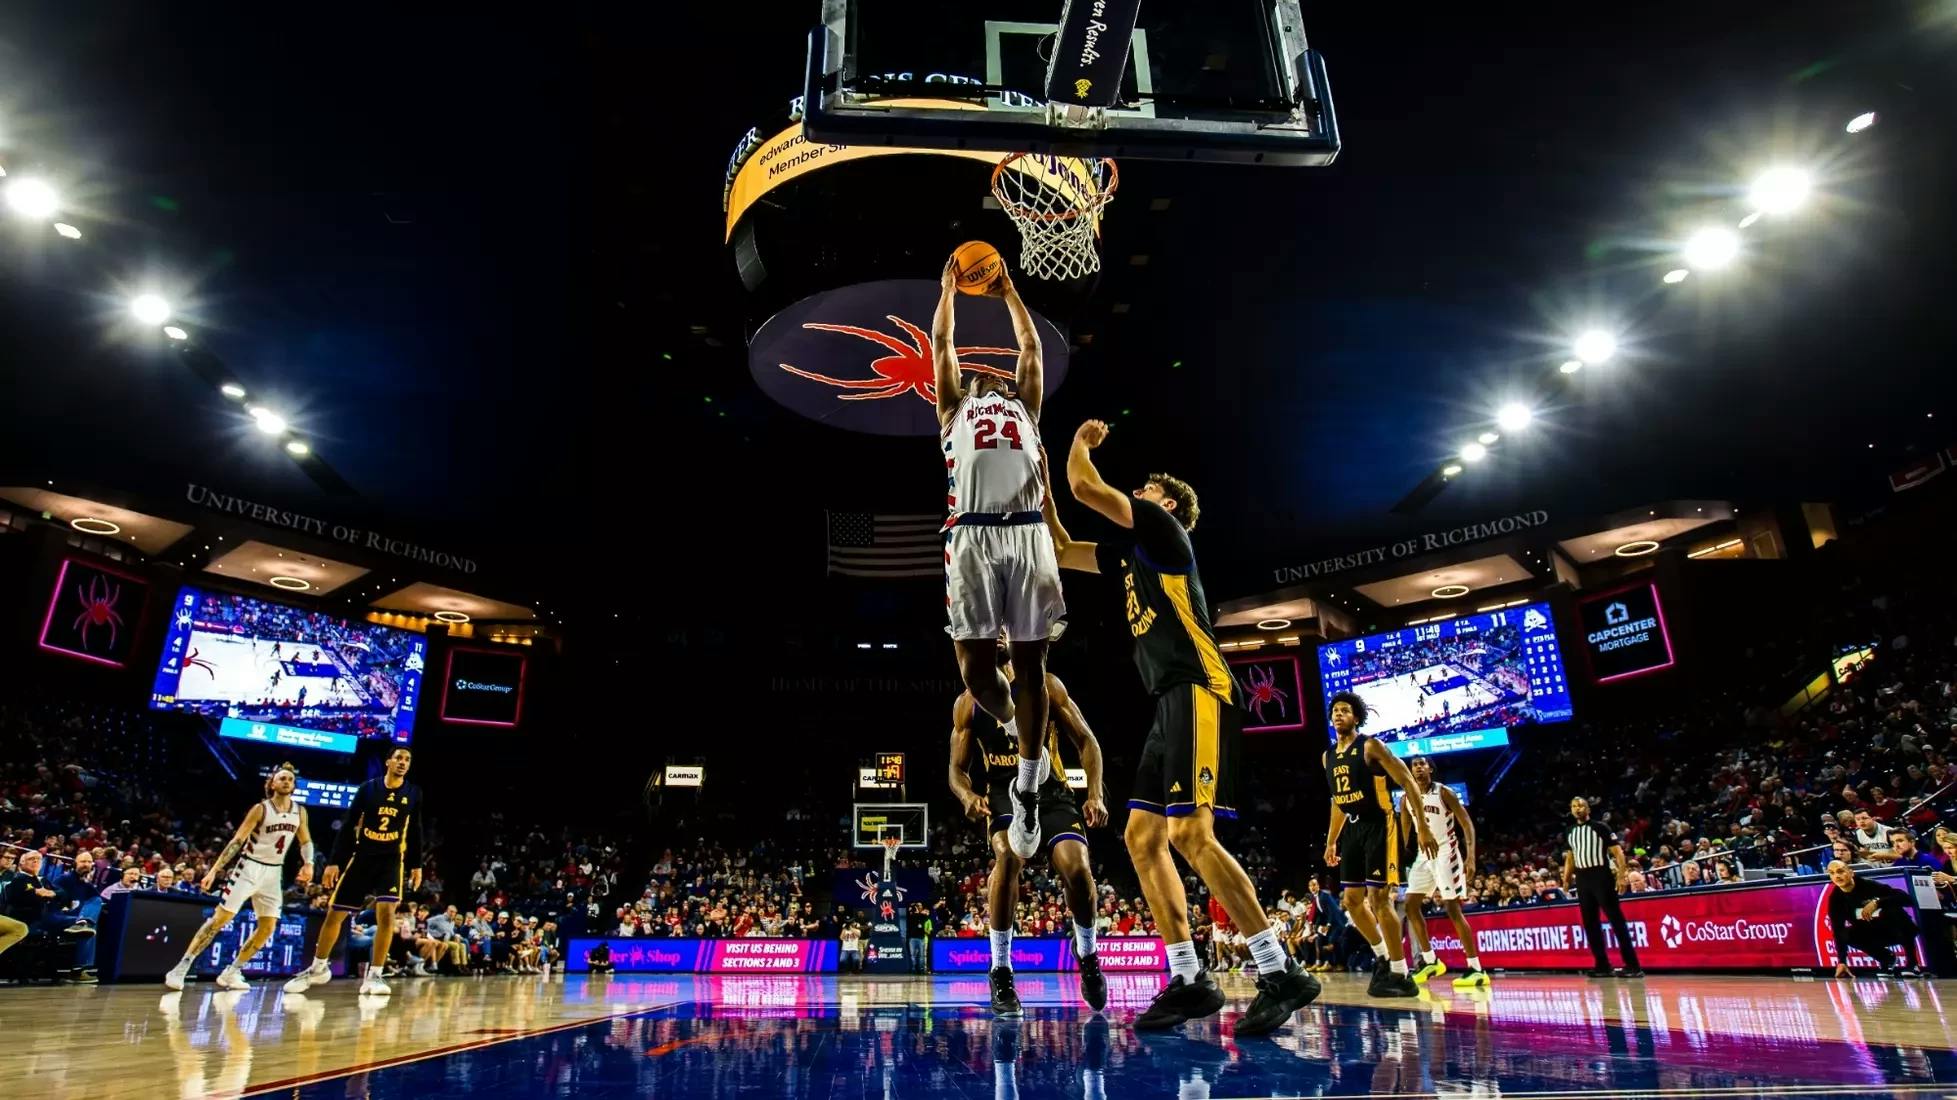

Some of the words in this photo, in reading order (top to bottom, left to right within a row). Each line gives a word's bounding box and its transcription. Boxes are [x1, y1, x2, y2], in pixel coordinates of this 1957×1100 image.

[1080, 20, 1107, 67] Results.
[760, 134, 807, 166] edward
[769, 146, 826, 180] Member
[966, 260, 998, 282] Wilson
[974, 418, 1023, 450] 24
[185, 483, 328, 537] UNIVERSITY
[332, 526, 361, 545] OF
[364, 531, 479, 575] RICHMOND
[1273, 546, 1386, 584] UNIVERSITY
[1391, 540, 1419, 558] OF
[1423, 510, 1549, 552] RICHMOND
[1131, 606, 1157, 638] OLINA
[1490, 612, 1507, 628] 11
[1588, 617, 1657, 644] CAPCENTER
[1355, 640, 1365, 653] 9
[1599, 632, 1650, 652] MORTGAGE
[989, 753, 1019, 766] CARO
[1333, 765, 1351, 778] EAST
[1336, 776, 1351, 793] 12
[378, 807, 399, 819] EAST
[380, 818, 391, 831] 2
[275, 835, 286, 854] 4
[726, 943, 750, 953] VISIT
[751, 943, 763, 953] US
[763, 943, 798, 954] BEHIND
[1096, 942, 1109, 951] SIT
[1110, 942, 1121, 951] US
[1122, 942, 1156, 951] BEHIND
[1477, 926, 1569, 953] CORNERSTONE
[211, 942, 222, 966] 9
[284, 945, 293, 966] 11
[722, 957, 765, 967] SECTIONS
[764, 957, 773, 967] 2
[773, 957, 793, 967] AND
[793, 957, 800, 967] 3
[1098, 956, 1126, 966] TIONS
[1126, 956, 1134, 966] 2
[1134, 956, 1153, 966] AND
[1153, 955, 1160, 965] 3
